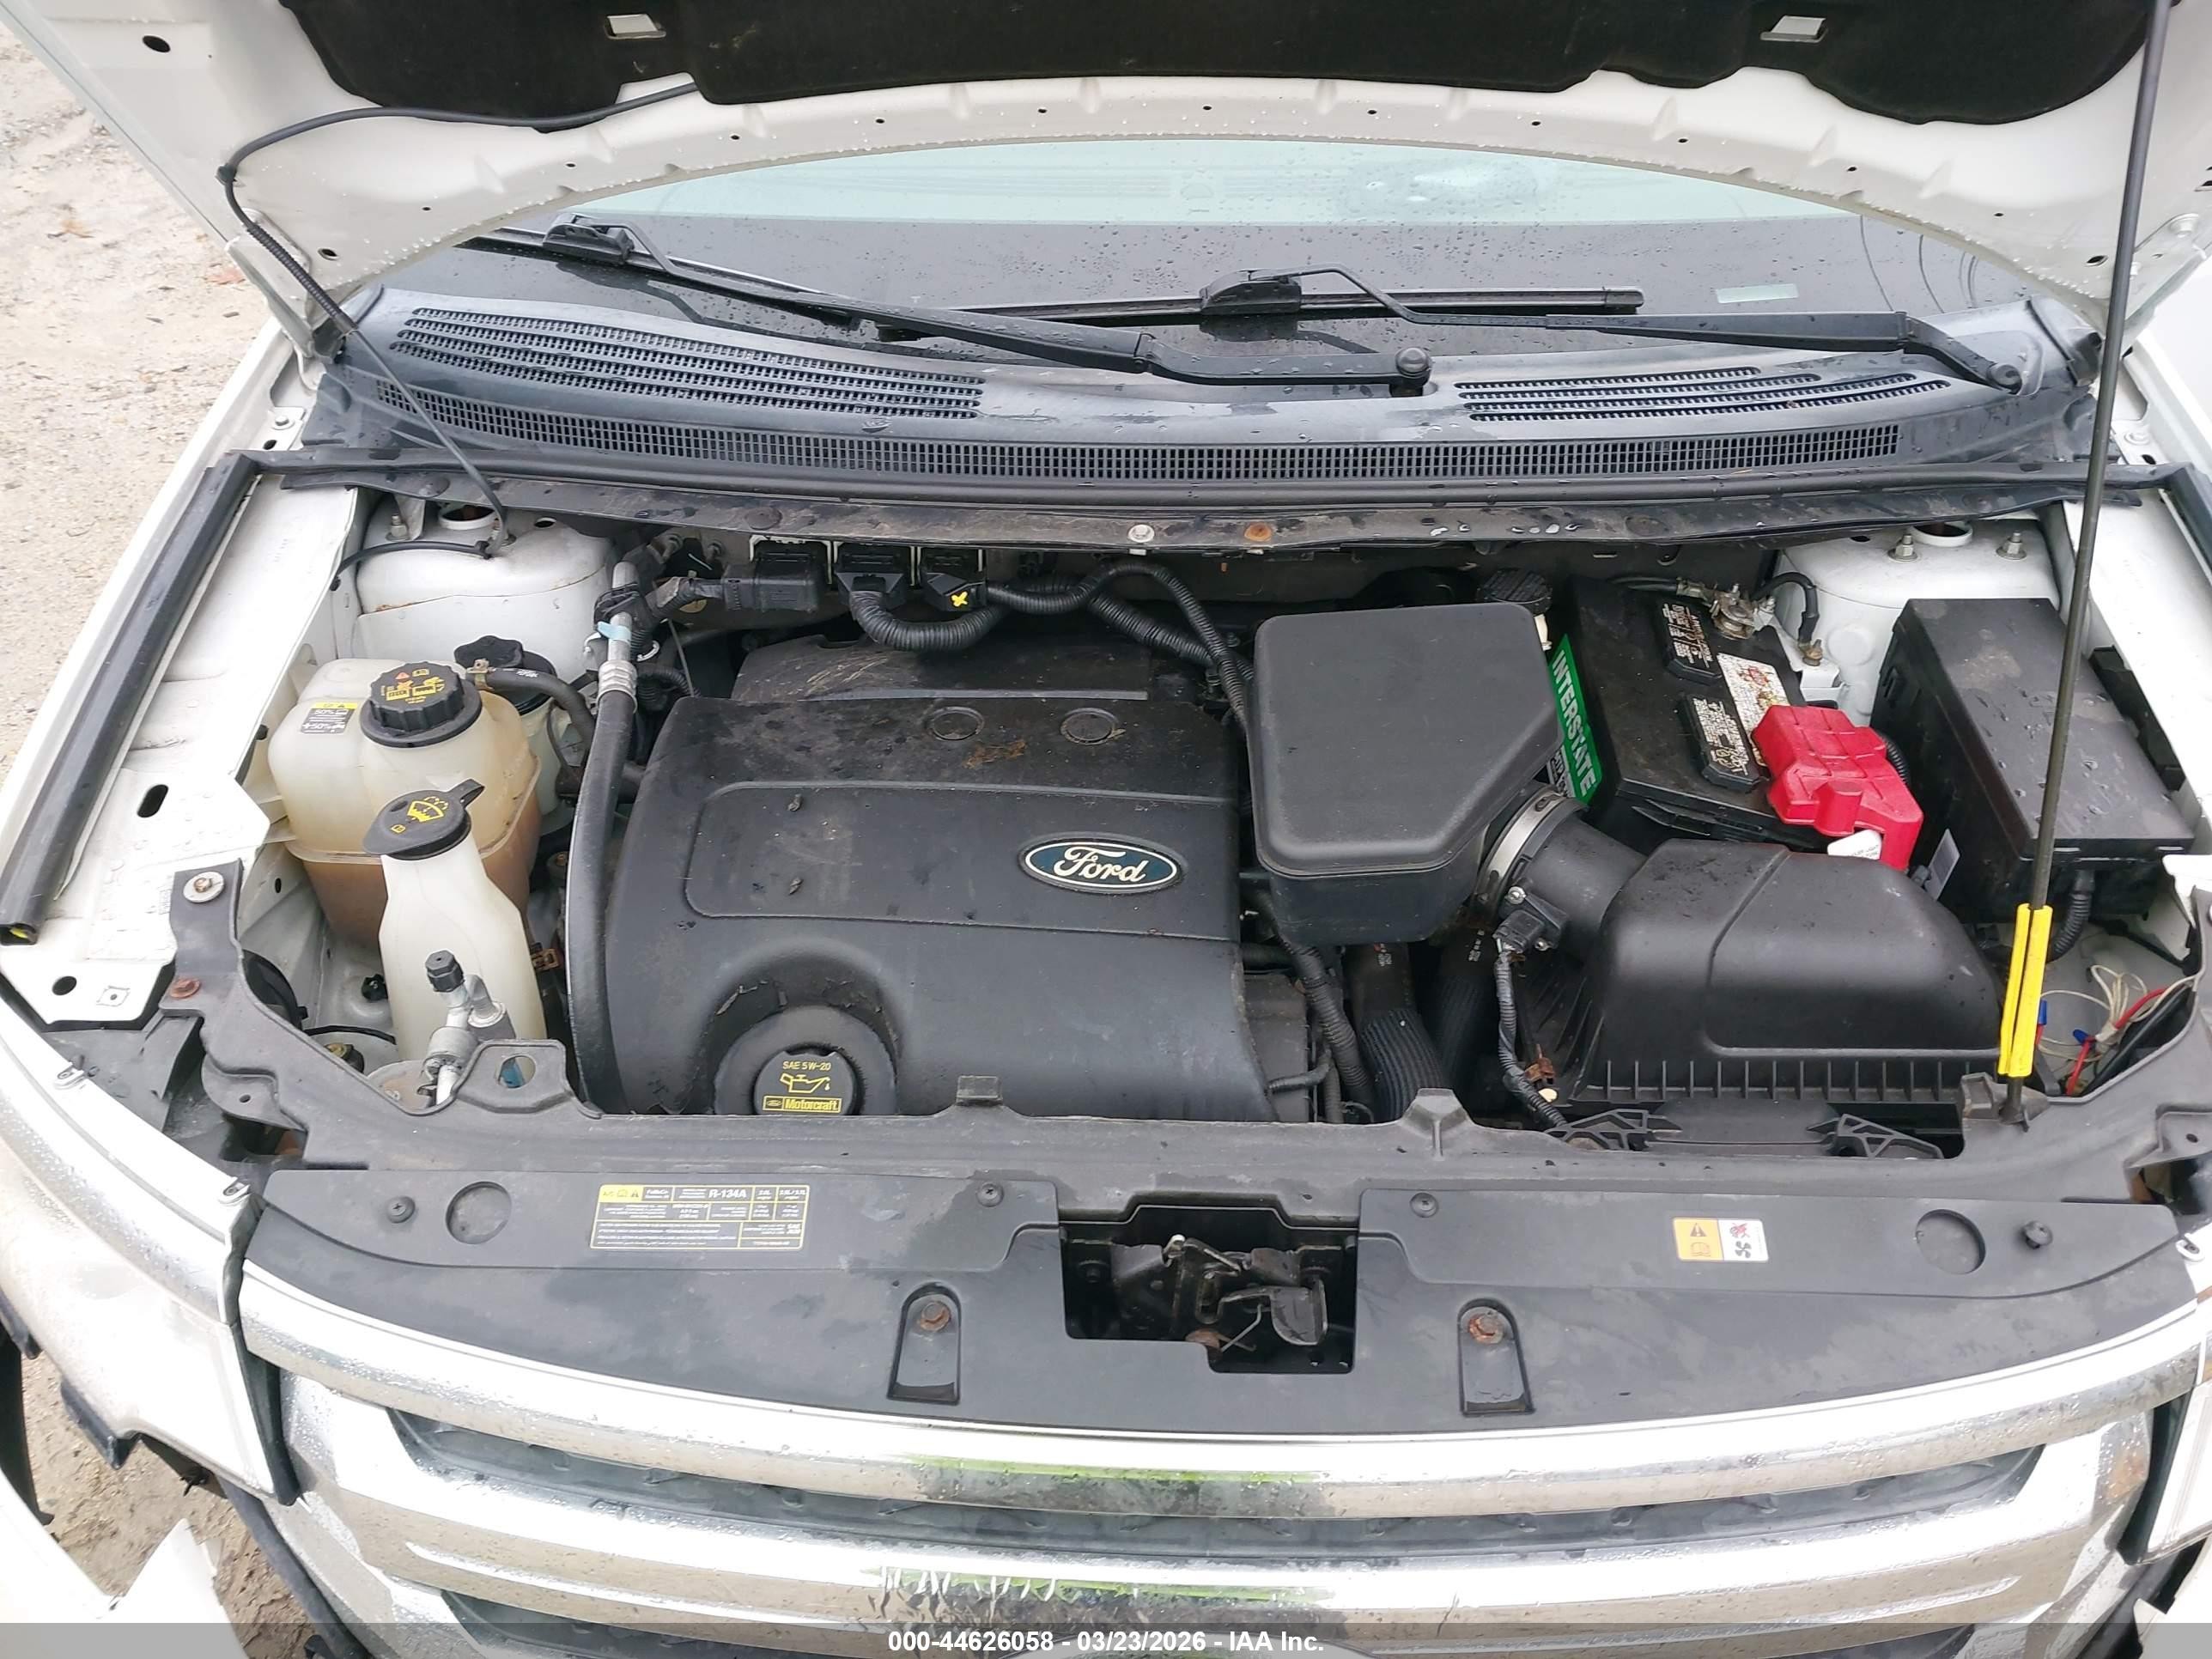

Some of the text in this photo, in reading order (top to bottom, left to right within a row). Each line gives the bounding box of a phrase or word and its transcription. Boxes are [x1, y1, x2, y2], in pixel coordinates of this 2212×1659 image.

[1552, 650, 1597, 796] INTERSTATE
[1053, 846, 1149, 883] Ford
[801, 1061, 831, 1071] 5W-20
[785, 1098, 838, 1111] Motorcraft
[708, 1188, 747, 1198] R-134A
